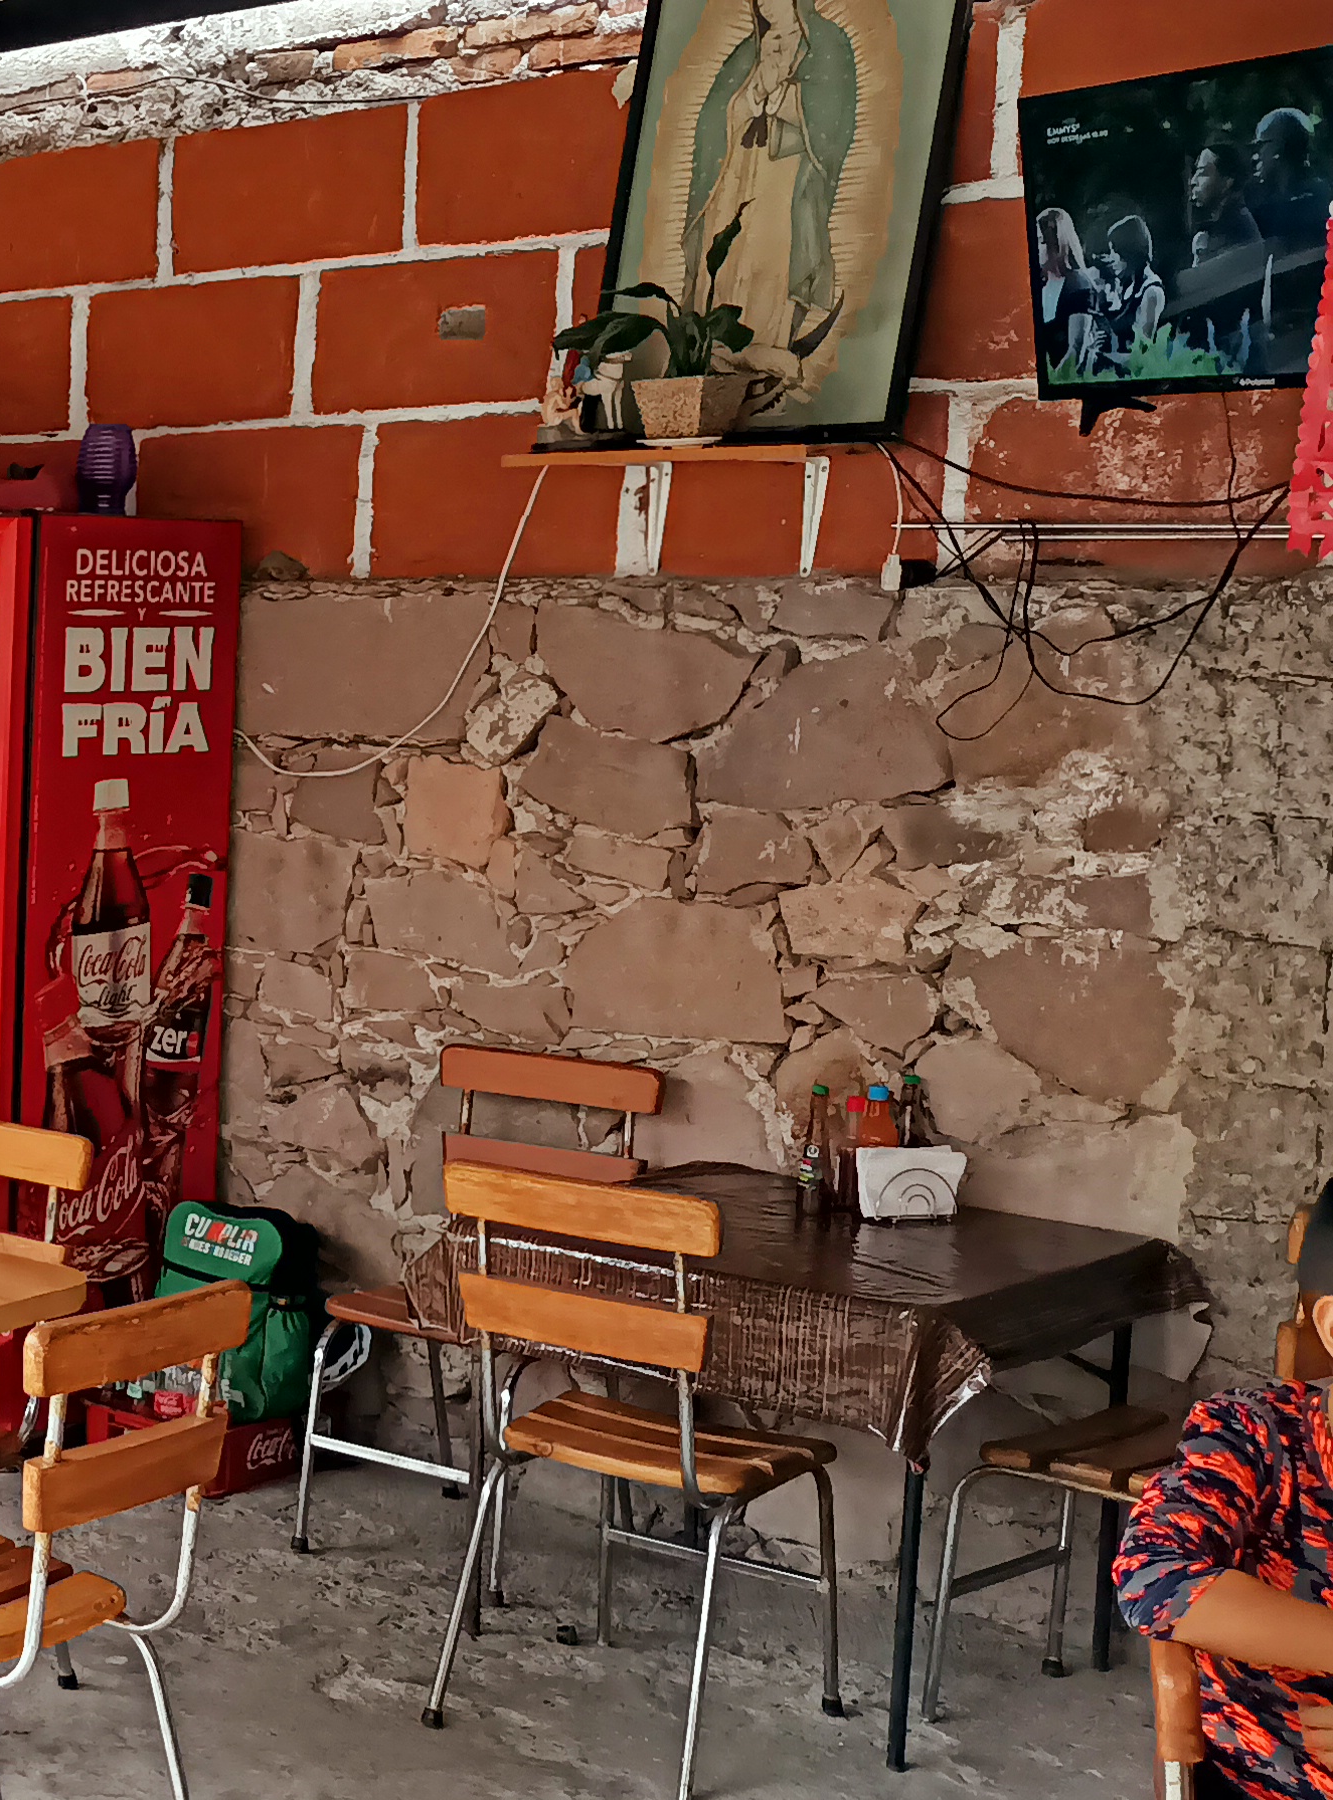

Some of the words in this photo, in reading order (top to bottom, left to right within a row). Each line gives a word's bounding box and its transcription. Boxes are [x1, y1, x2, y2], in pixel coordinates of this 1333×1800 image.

[76, 548, 208, 577] DELICIOSA
[66, 580, 216, 603] REFRESCANTE
[137, 607, 146, 621] Y
[64, 626, 215, 693] BIEN
[61, 696, 209, 758] FRÍA
[55, 1143, 139, 1241] oca-Cola
